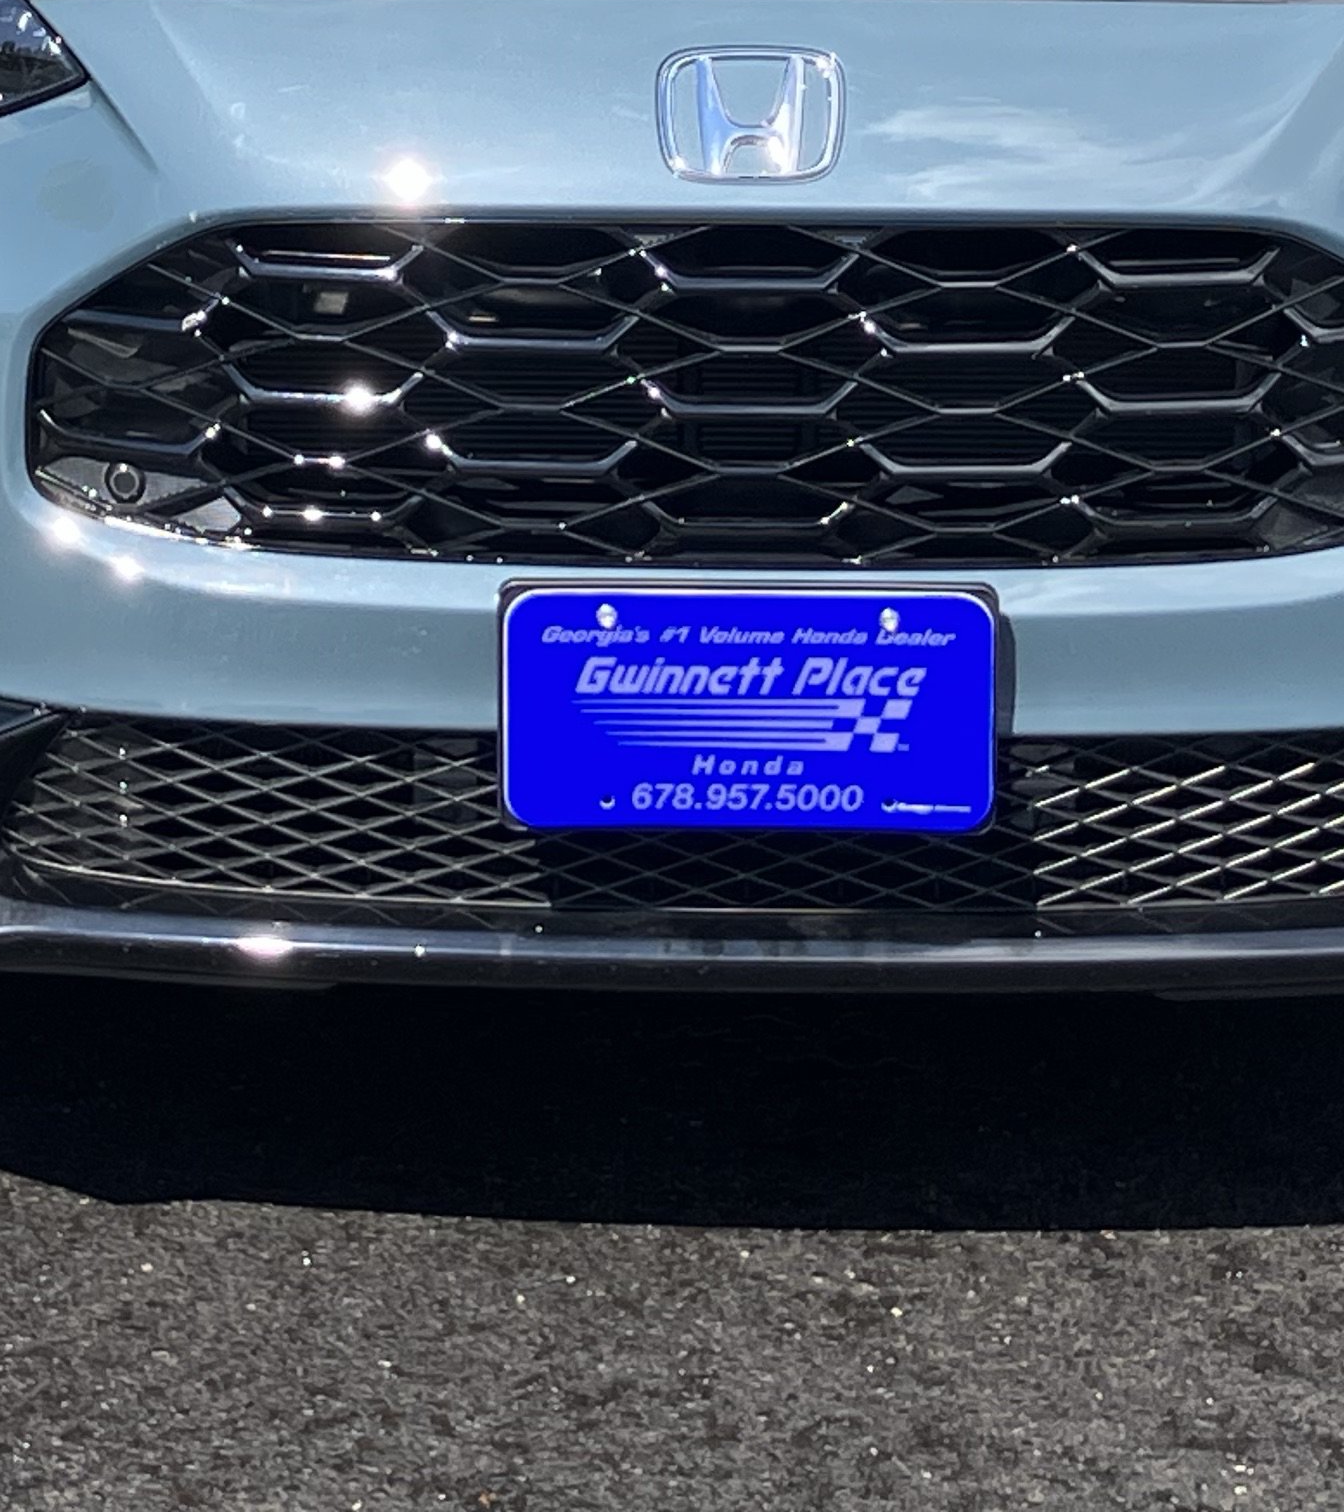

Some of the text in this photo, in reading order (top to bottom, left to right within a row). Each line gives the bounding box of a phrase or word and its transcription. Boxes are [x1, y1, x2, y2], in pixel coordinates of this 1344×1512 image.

[659, 625, 692, 644] #1
[699, 626, 786, 645] Volume
[791, 627, 869, 646] Honda
[874, 628, 957, 647] Dealer
[574, 655, 928, 697] Gwinnett Place
[691, 754, 805, 776] Honda
[631, 782, 865, 812] 678.957.5000
